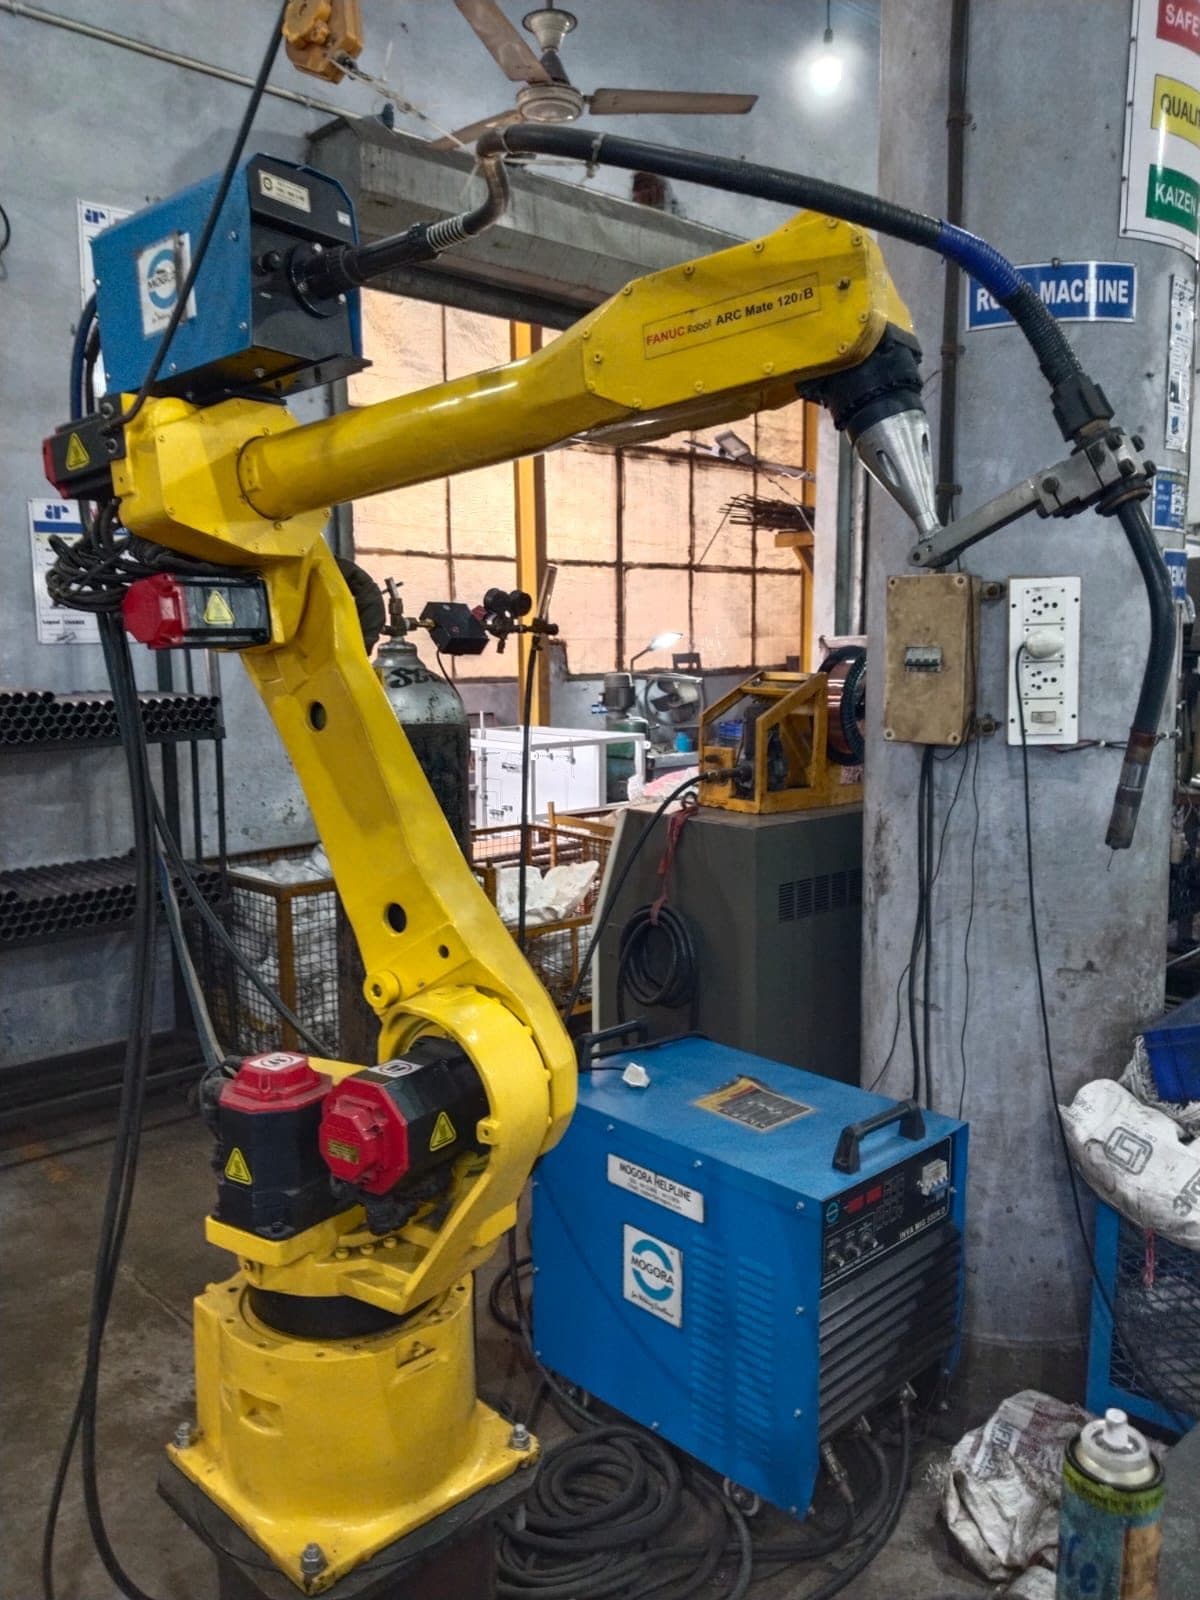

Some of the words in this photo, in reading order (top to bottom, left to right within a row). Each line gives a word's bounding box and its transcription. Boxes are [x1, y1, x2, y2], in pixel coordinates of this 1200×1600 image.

[1155, 182, 1196, 217] KAIZEN
[1039, 279, 1129, 305] MACHINE
[646, 326, 686, 346] FANUC
[716, 309, 742, 326] ARC
[744, 301, 773, 318] Mate
[619, 1162, 652, 1185] MOGORA
[655, 1174, 691, 1202] HELPLINE
[631, 1255, 674, 1286] MOGORA
